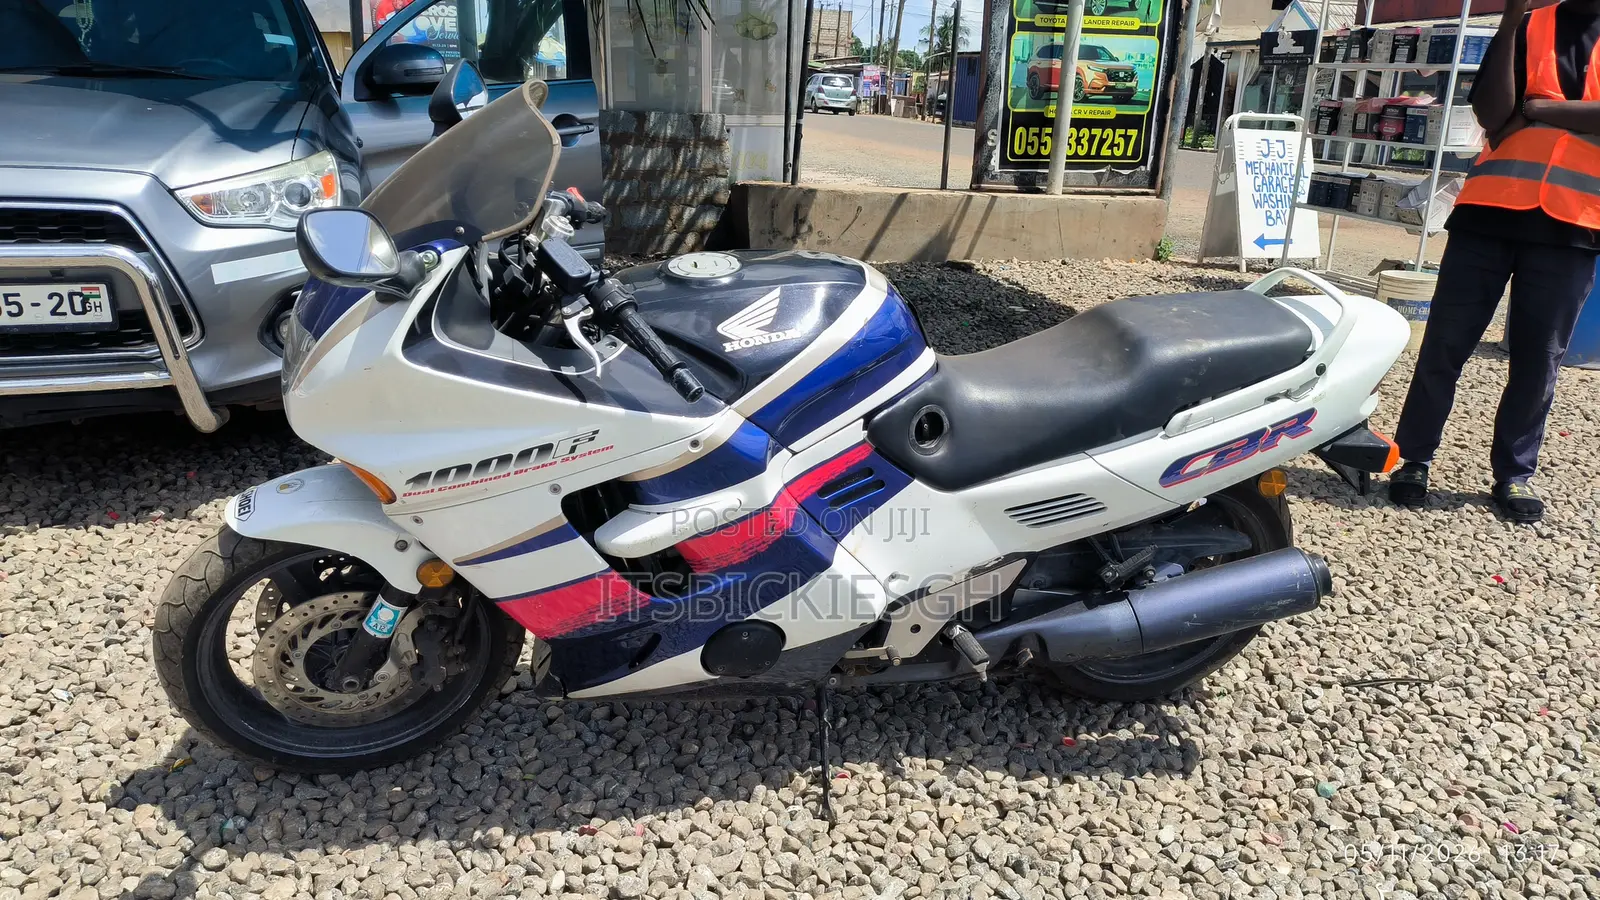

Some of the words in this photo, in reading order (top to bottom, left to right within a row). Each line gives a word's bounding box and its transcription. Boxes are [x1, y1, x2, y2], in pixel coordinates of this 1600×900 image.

[1039, 16, 1066, 24] TOYOTA
[1014, 126, 1138, 157] 055337257
[1253, 175, 1296, 194] GARAGE
[1265, 209, 1288, 227] BAY
[722, 327, 802, 352] HONDA
[404, 429, 600, 491] 1000F
[1158, 407, 1318, 488] CBR
[436, 471, 511, 492] Combined
[513, 460, 558, 476] Brake
[559, 444, 614, 464] System
